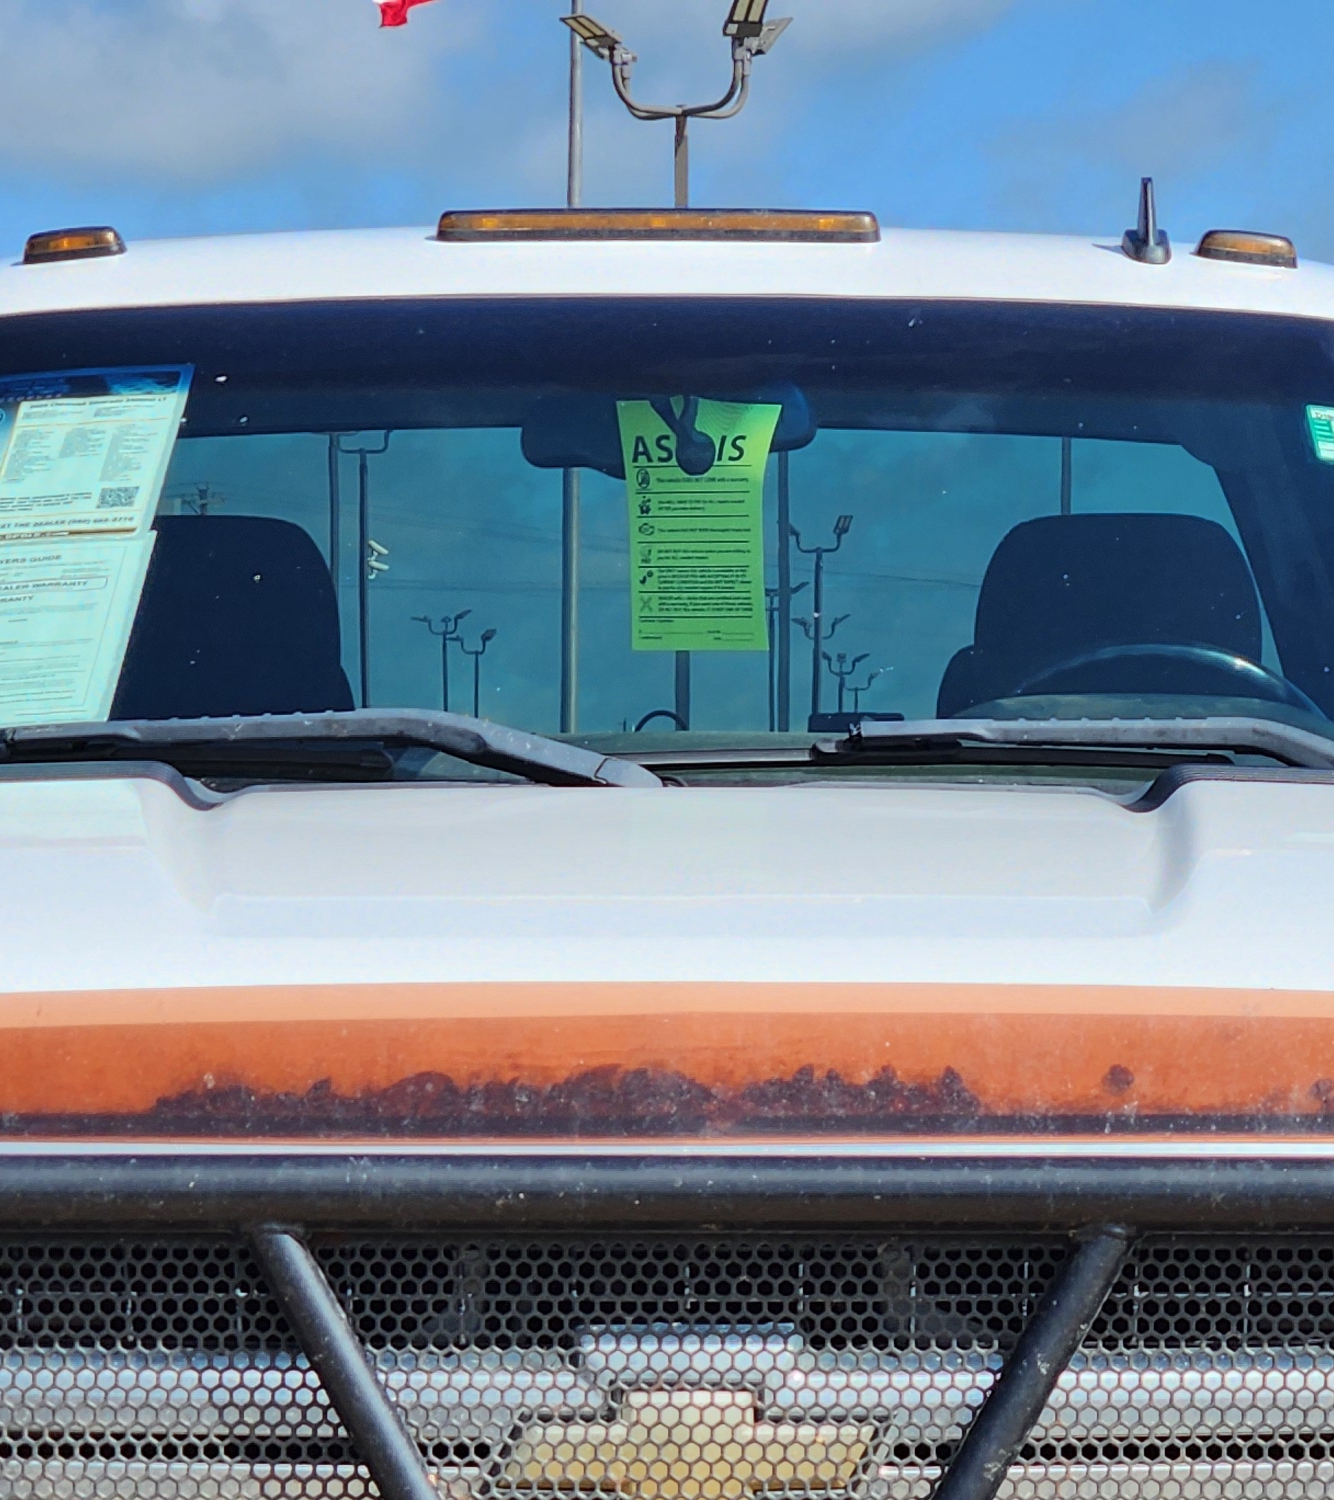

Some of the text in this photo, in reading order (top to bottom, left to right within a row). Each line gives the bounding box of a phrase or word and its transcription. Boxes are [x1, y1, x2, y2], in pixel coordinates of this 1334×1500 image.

[631, 434, 747, 463] AS IS
[29, 554, 62, 563] GUIDE
[32, 580, 88, 590] WARRANTY
